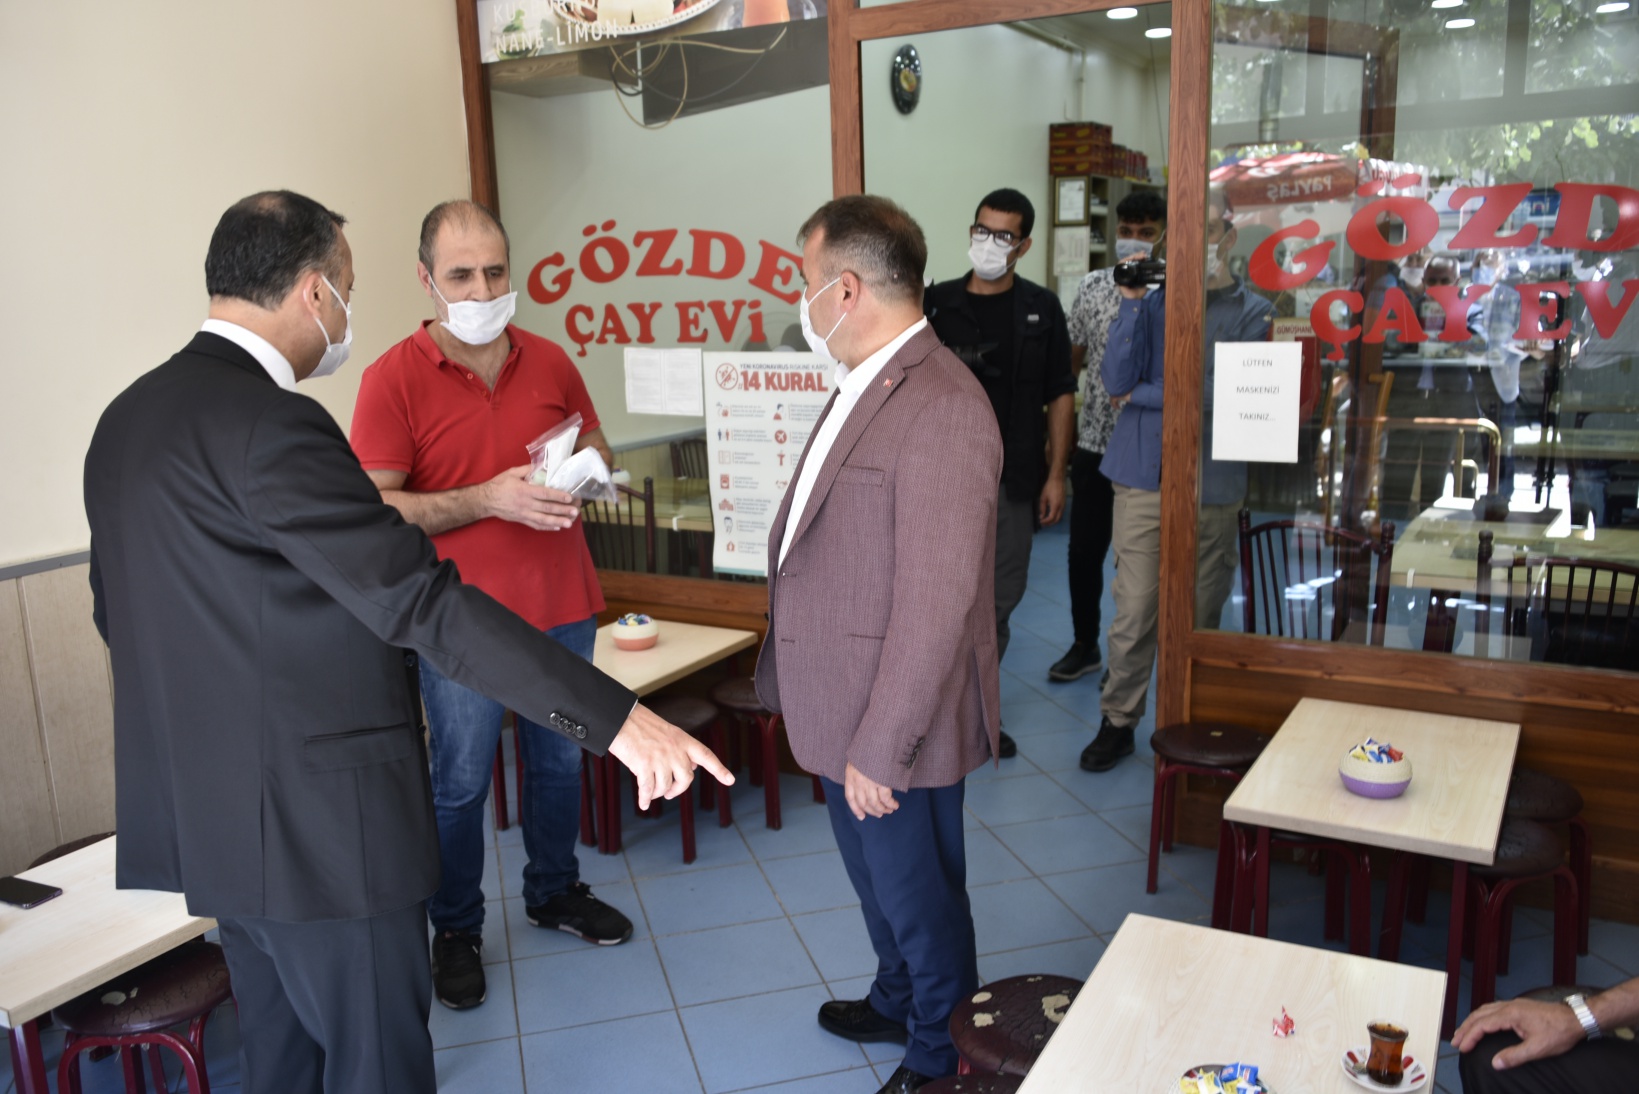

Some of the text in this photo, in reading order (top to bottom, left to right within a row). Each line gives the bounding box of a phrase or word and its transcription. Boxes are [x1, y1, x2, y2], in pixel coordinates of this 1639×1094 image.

[528, 219, 804, 305] GÖZDE
[565, 303, 662, 358] ÇAY
[1311, 286, 1491, 361] ÇAY
[741, 370, 828, 392] 14 KURAL
[1242, 358, 1273, 367] LÜTFEN
